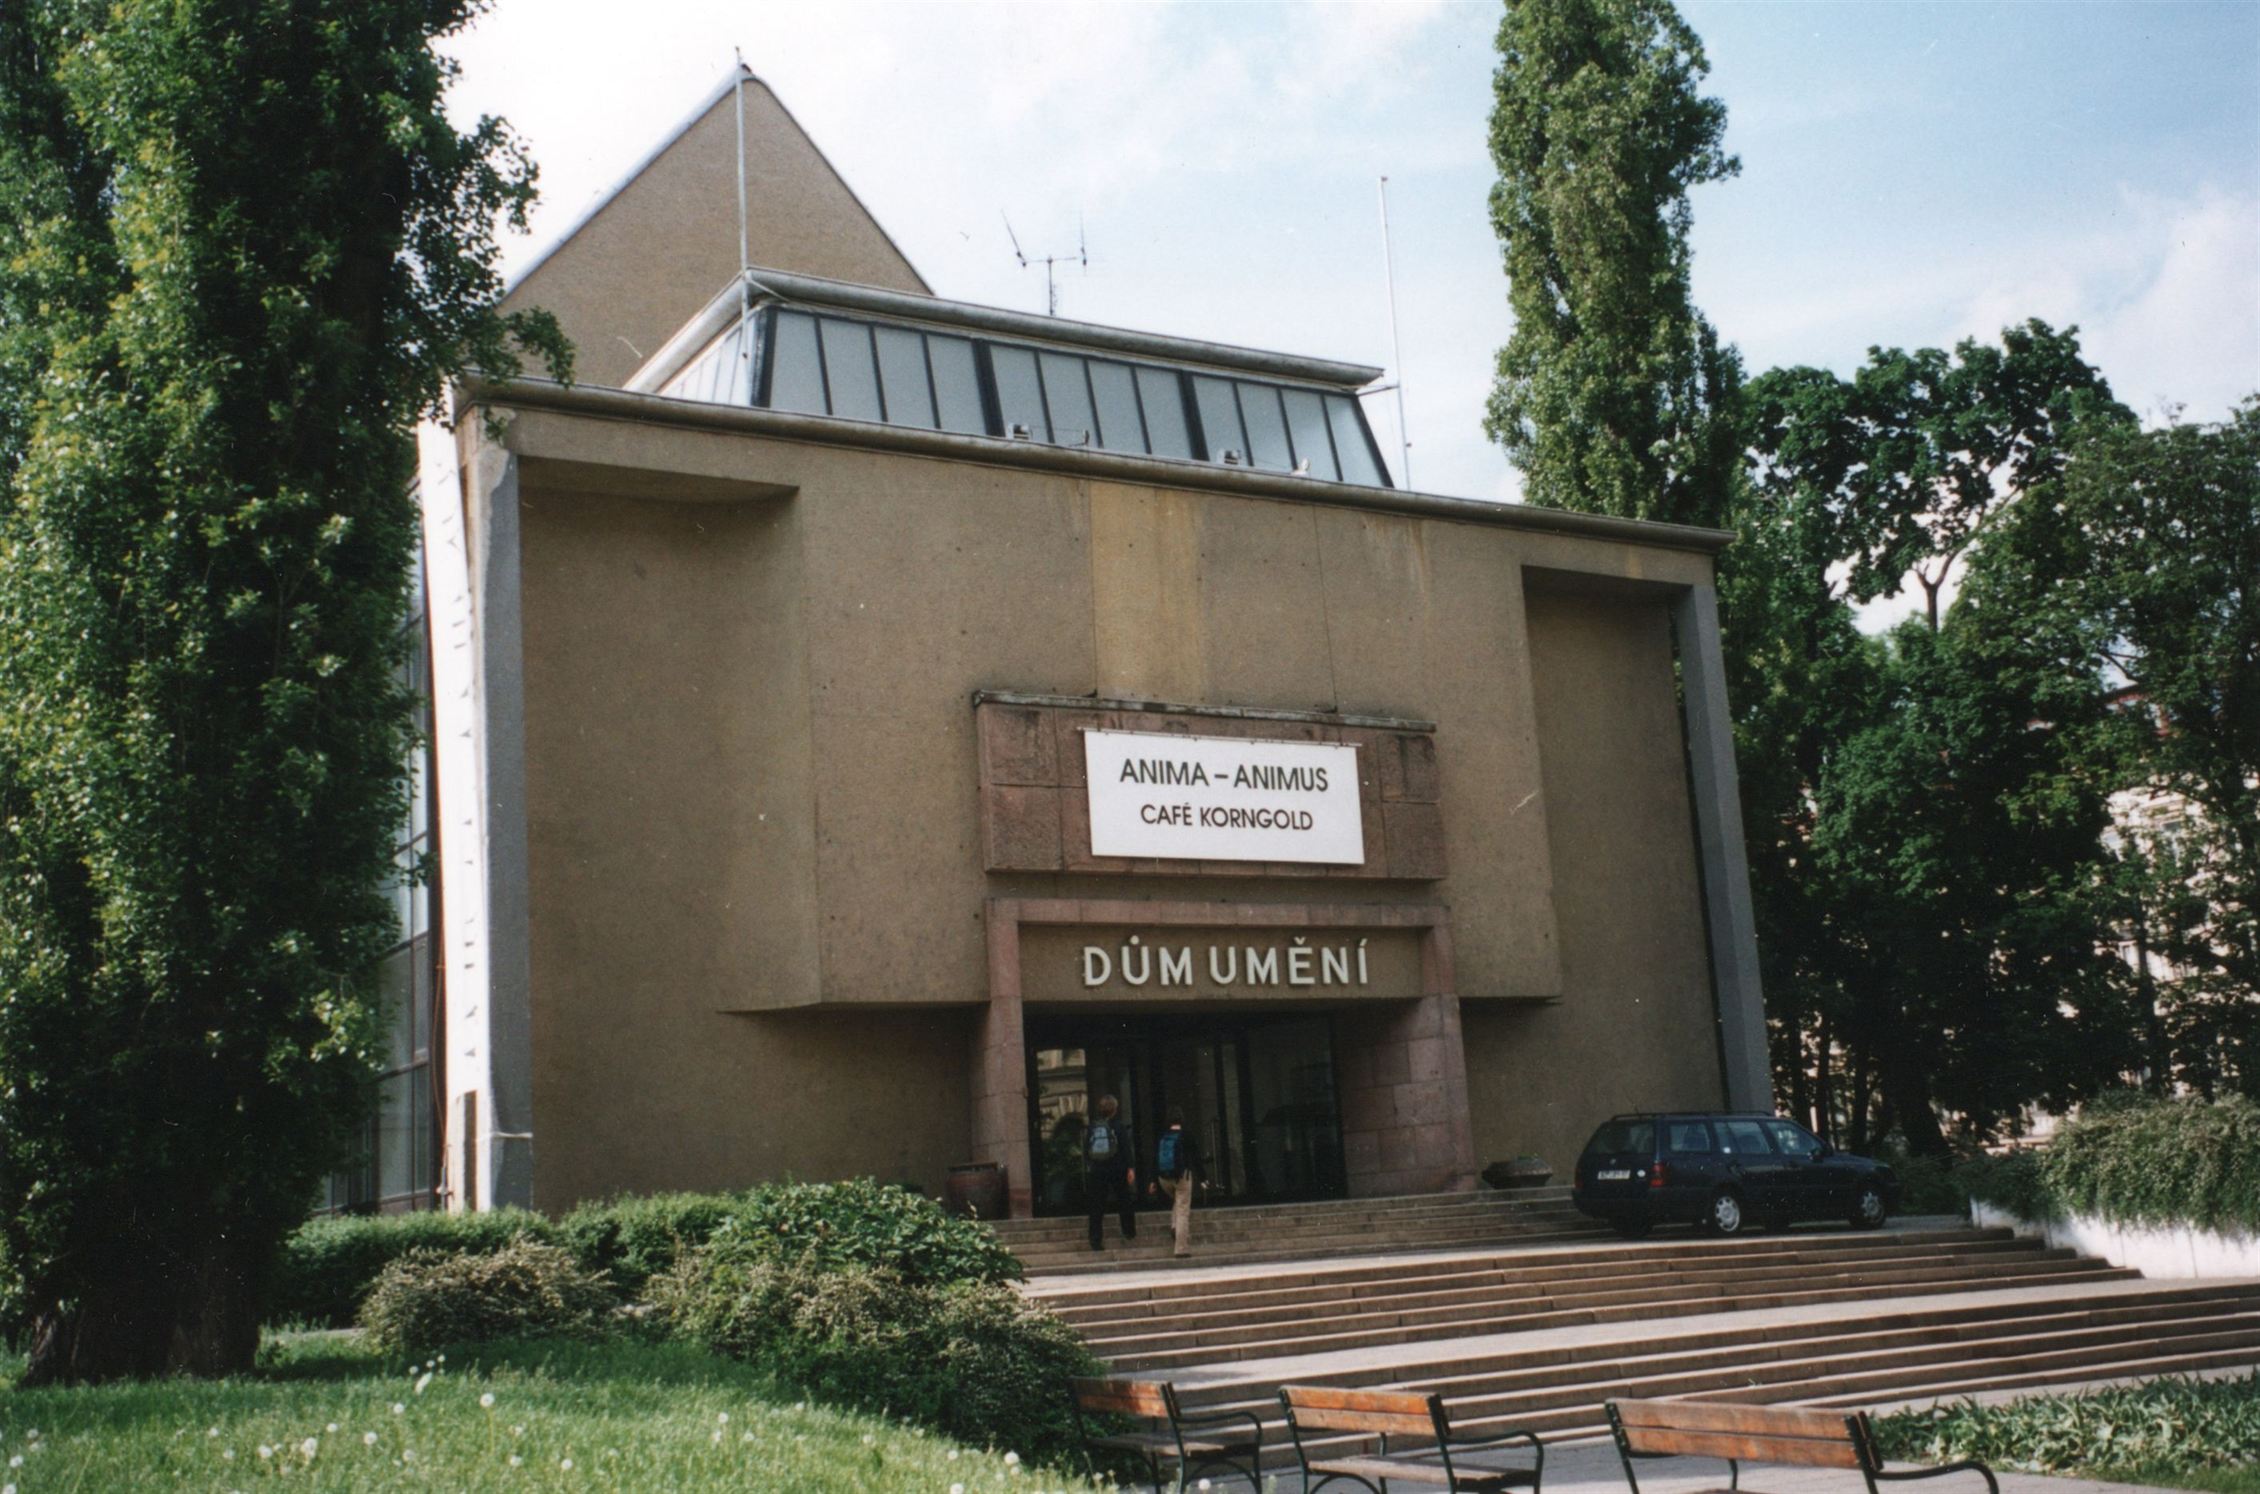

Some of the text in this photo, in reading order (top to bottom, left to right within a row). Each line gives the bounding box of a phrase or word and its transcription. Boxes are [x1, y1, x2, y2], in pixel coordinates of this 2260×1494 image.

[1120, 758, 1210, 787] ANIMA
[1234, 764, 1329, 792] ANIMUS
[1140, 802, 1313, 831] CAFÉ KORNGOLD
[1083, 935, 1368, 986] DŮM UMĚNÍ
